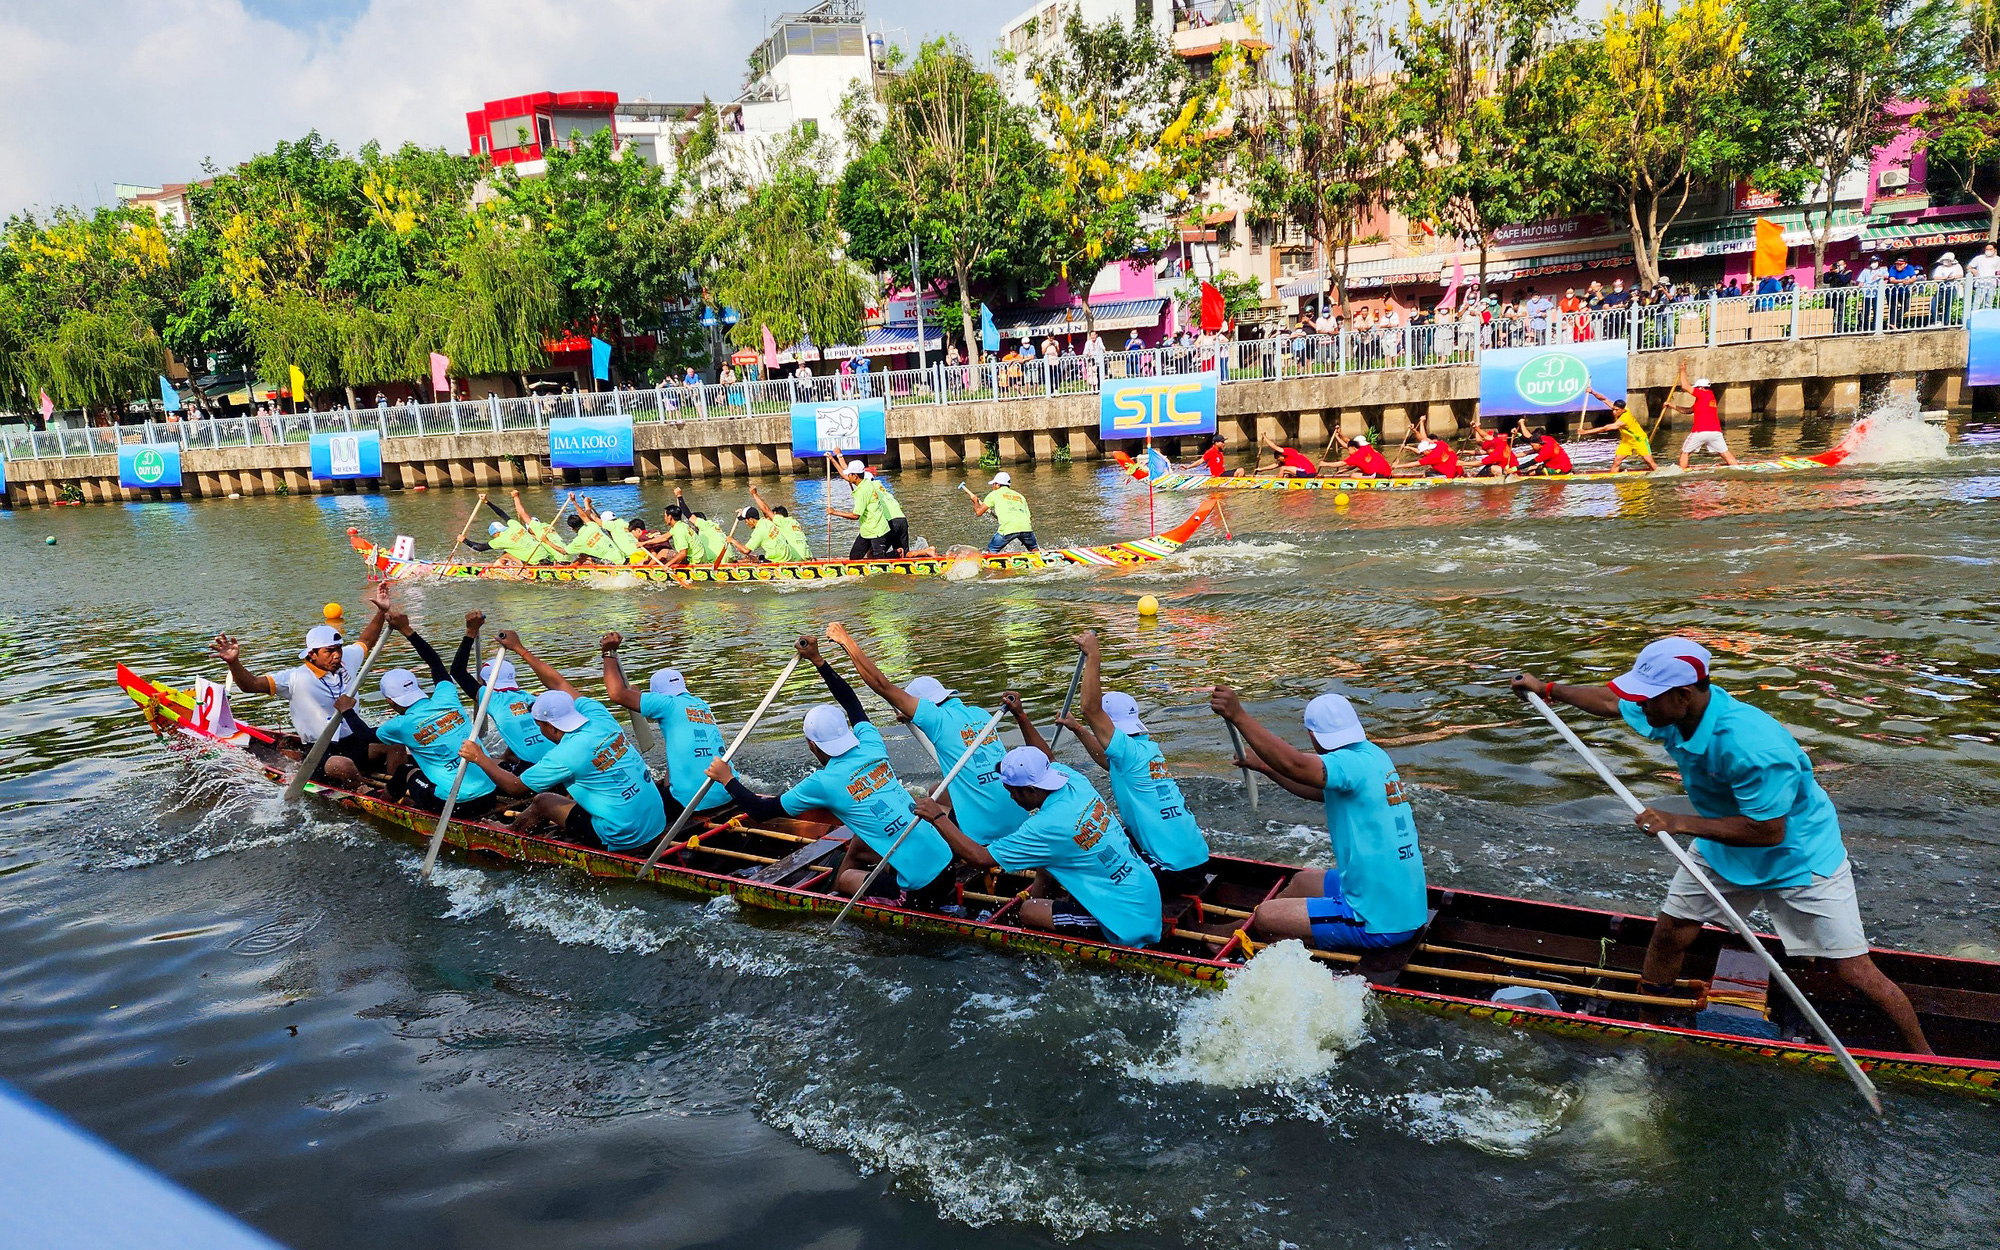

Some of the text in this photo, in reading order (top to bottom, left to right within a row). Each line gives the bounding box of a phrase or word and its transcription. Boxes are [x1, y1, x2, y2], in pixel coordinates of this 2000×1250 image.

[1496, 229, 1520, 240] CAFE
[1527, 377, 1579, 396] DUY LỢI
[1114, 383, 1202, 430] STC
[554, 434, 618, 450] IMA KOKO
[138, 464, 161, 477] DUY LỢI
[524, 733, 544, 746] STC
[694, 747, 713, 758] STC
[976, 770, 1000, 785] STC
[621, 782, 640, 801] STC
[1160, 805, 1182, 820] STC
[884, 814, 909, 838] STC
[1109, 860, 1133, 886] STC
